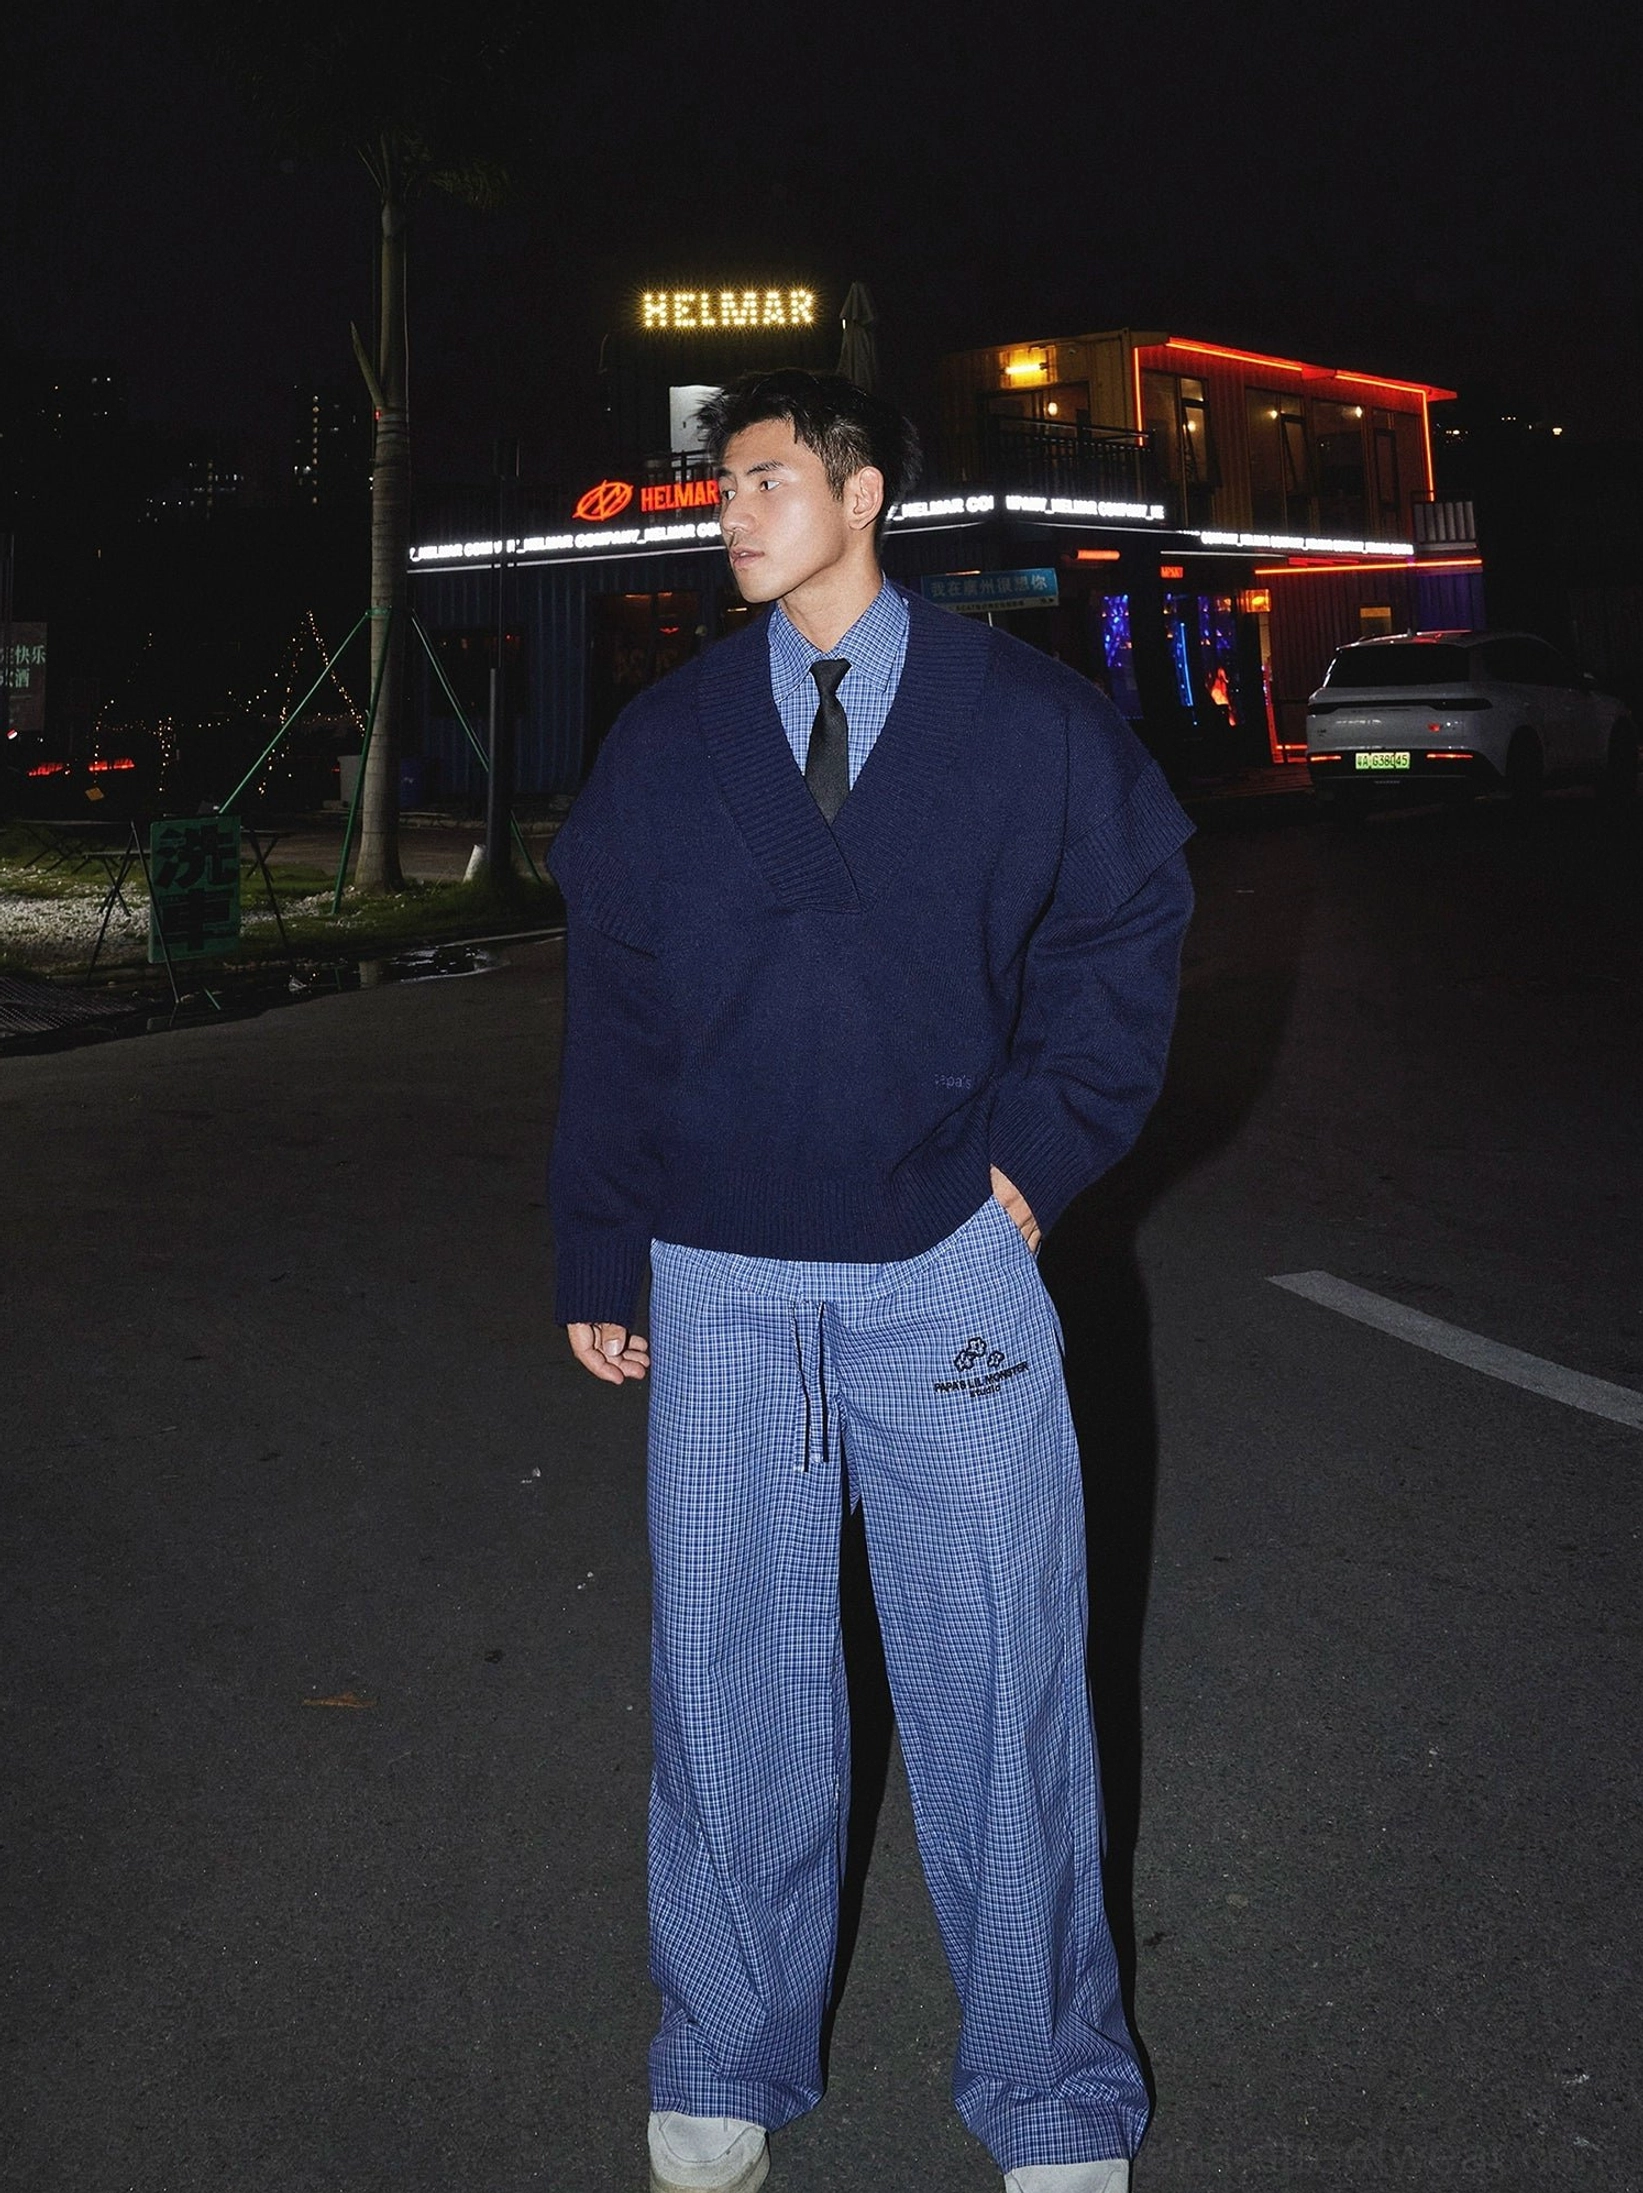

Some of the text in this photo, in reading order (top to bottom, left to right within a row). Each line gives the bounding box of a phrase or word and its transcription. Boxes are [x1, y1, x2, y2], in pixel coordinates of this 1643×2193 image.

[643, 290, 814, 327] HELMAR
[641, 479, 720, 512] HELMAR
[985, 1361, 1029, 1385] MONSTER
